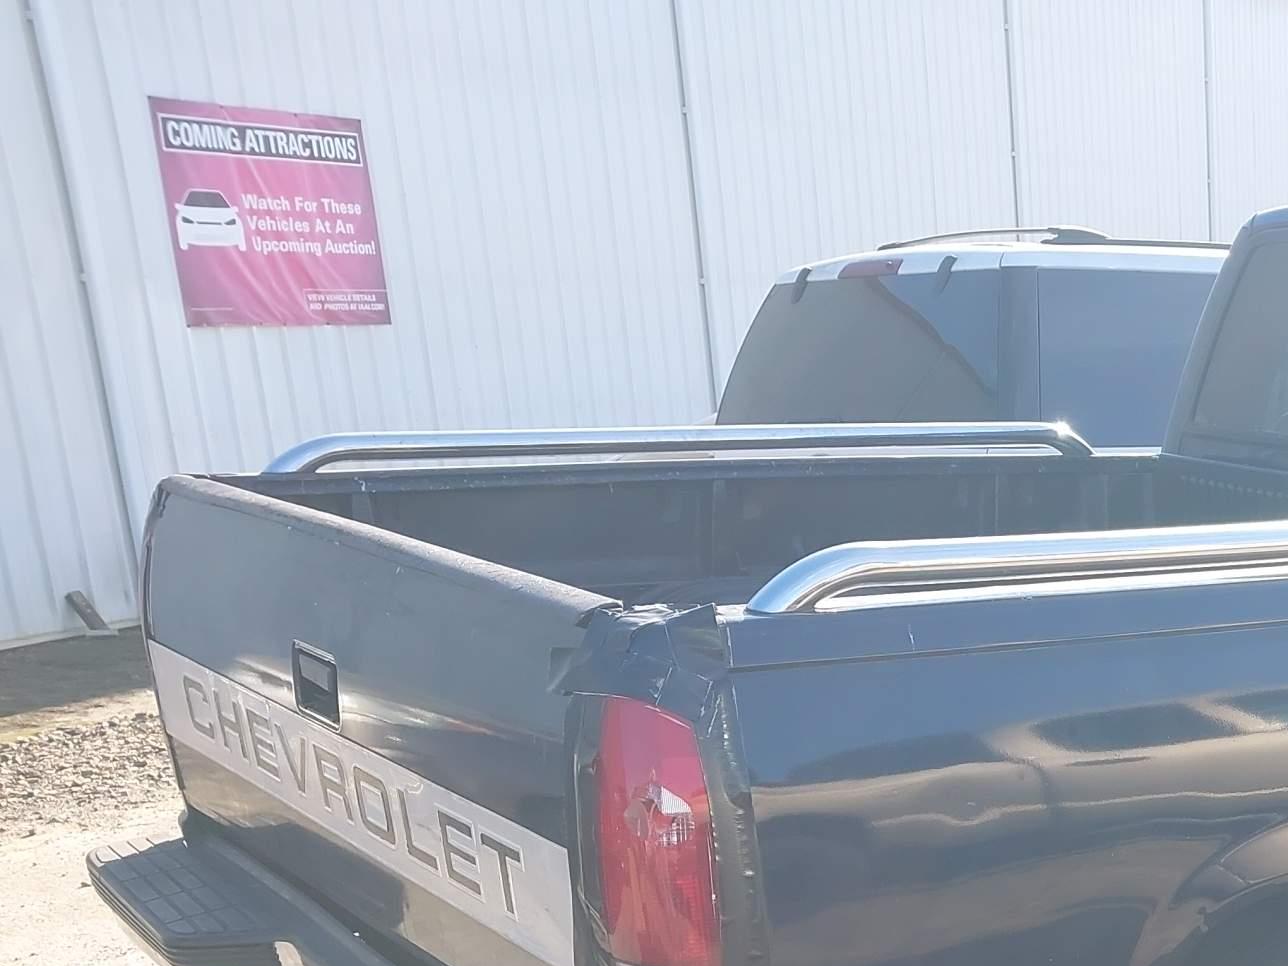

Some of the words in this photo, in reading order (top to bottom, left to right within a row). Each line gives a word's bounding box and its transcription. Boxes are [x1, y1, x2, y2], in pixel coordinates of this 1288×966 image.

[165, 120, 242, 152] COMING
[244, 129, 358, 161] ATTRACTIONS
[240, 194, 291, 211] Watch
[294, 197, 318, 213] For
[320, 198, 362, 216] These
[246, 215, 310, 233] Vehicles
[314, 219, 332, 234] At
[335, 219, 355, 235] An
[252, 236, 322, 257] Upcoming
[324, 239, 376, 256] Auction!
[182, 674, 526, 923] CHEVROLET
